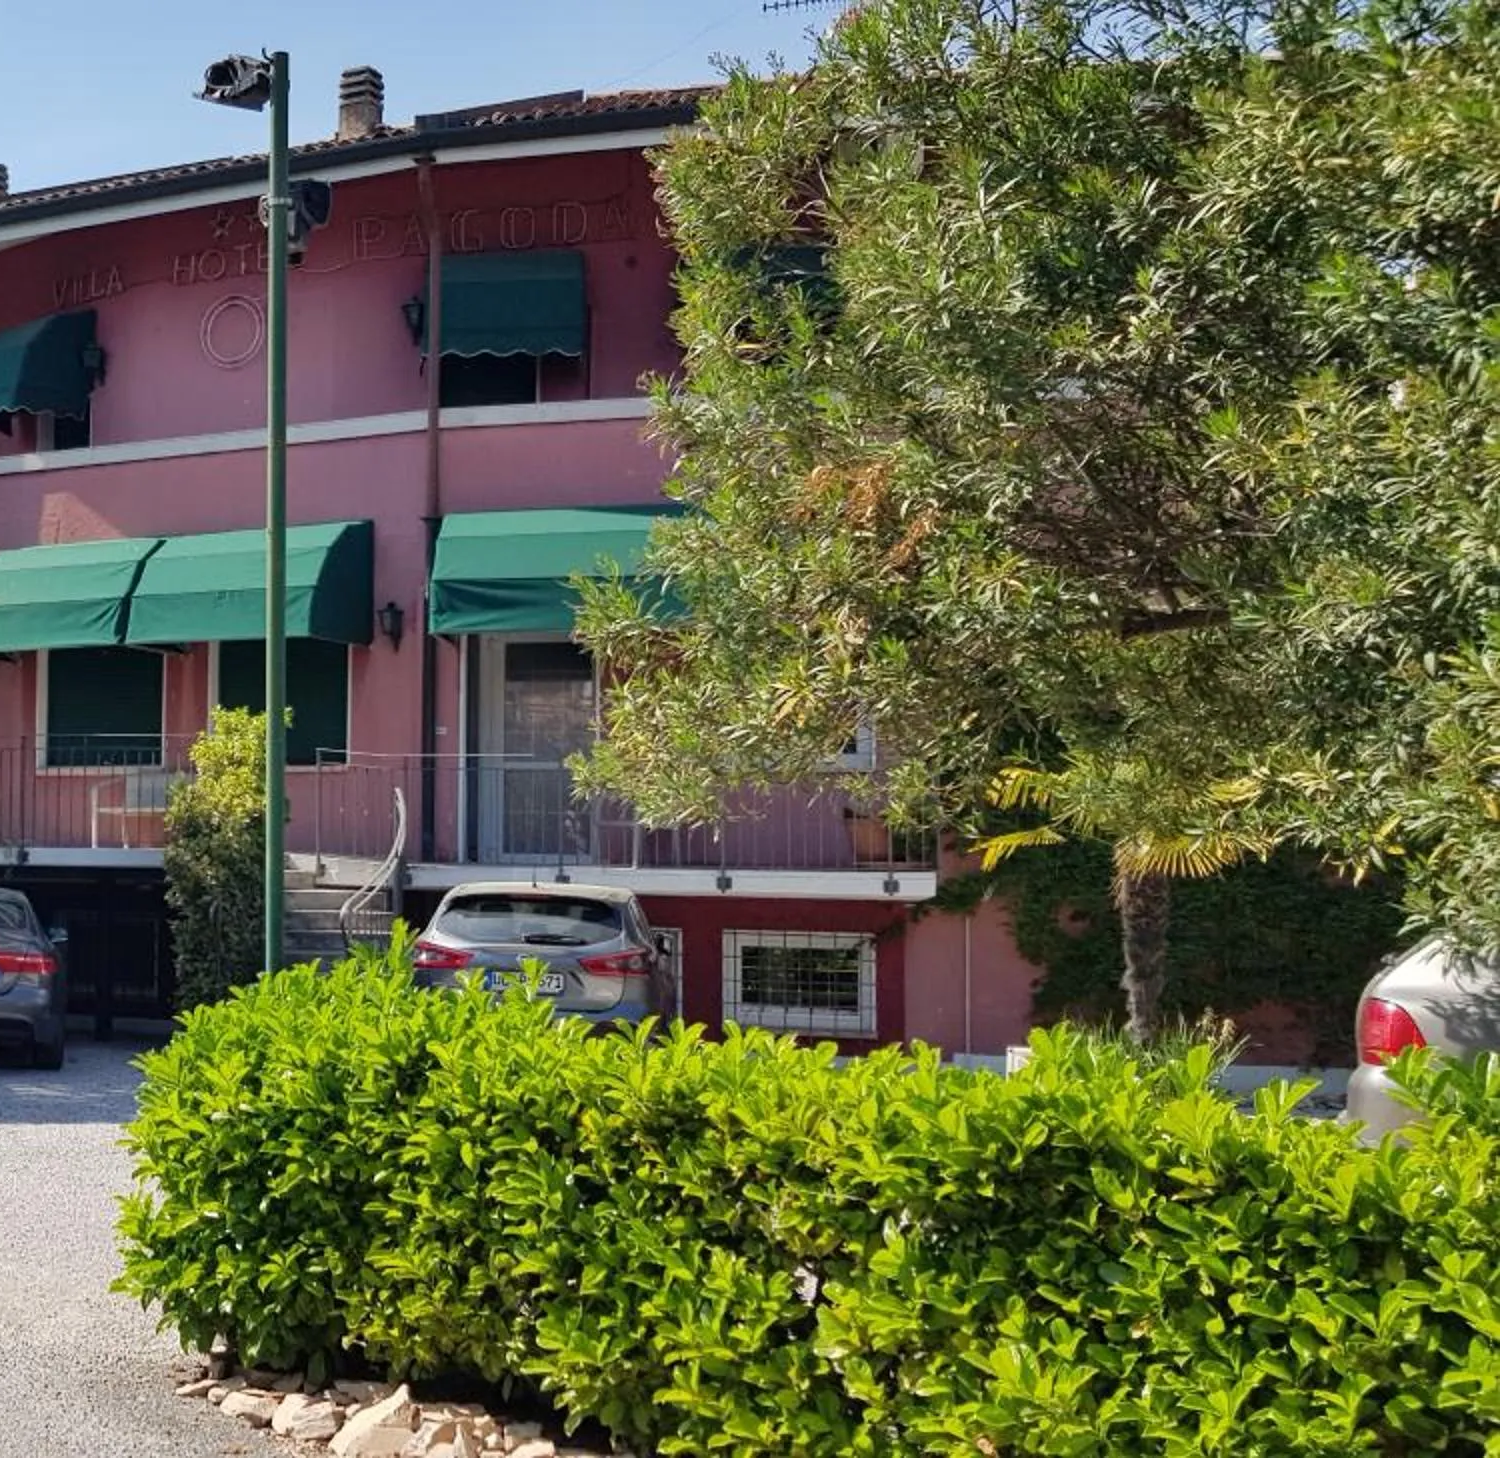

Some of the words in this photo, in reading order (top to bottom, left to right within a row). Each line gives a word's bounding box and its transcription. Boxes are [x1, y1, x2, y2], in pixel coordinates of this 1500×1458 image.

[52, 264, 124, 307] VILLA
[171, 243, 270, 286] HOTE
[352, 200, 630, 259] PAGODA
